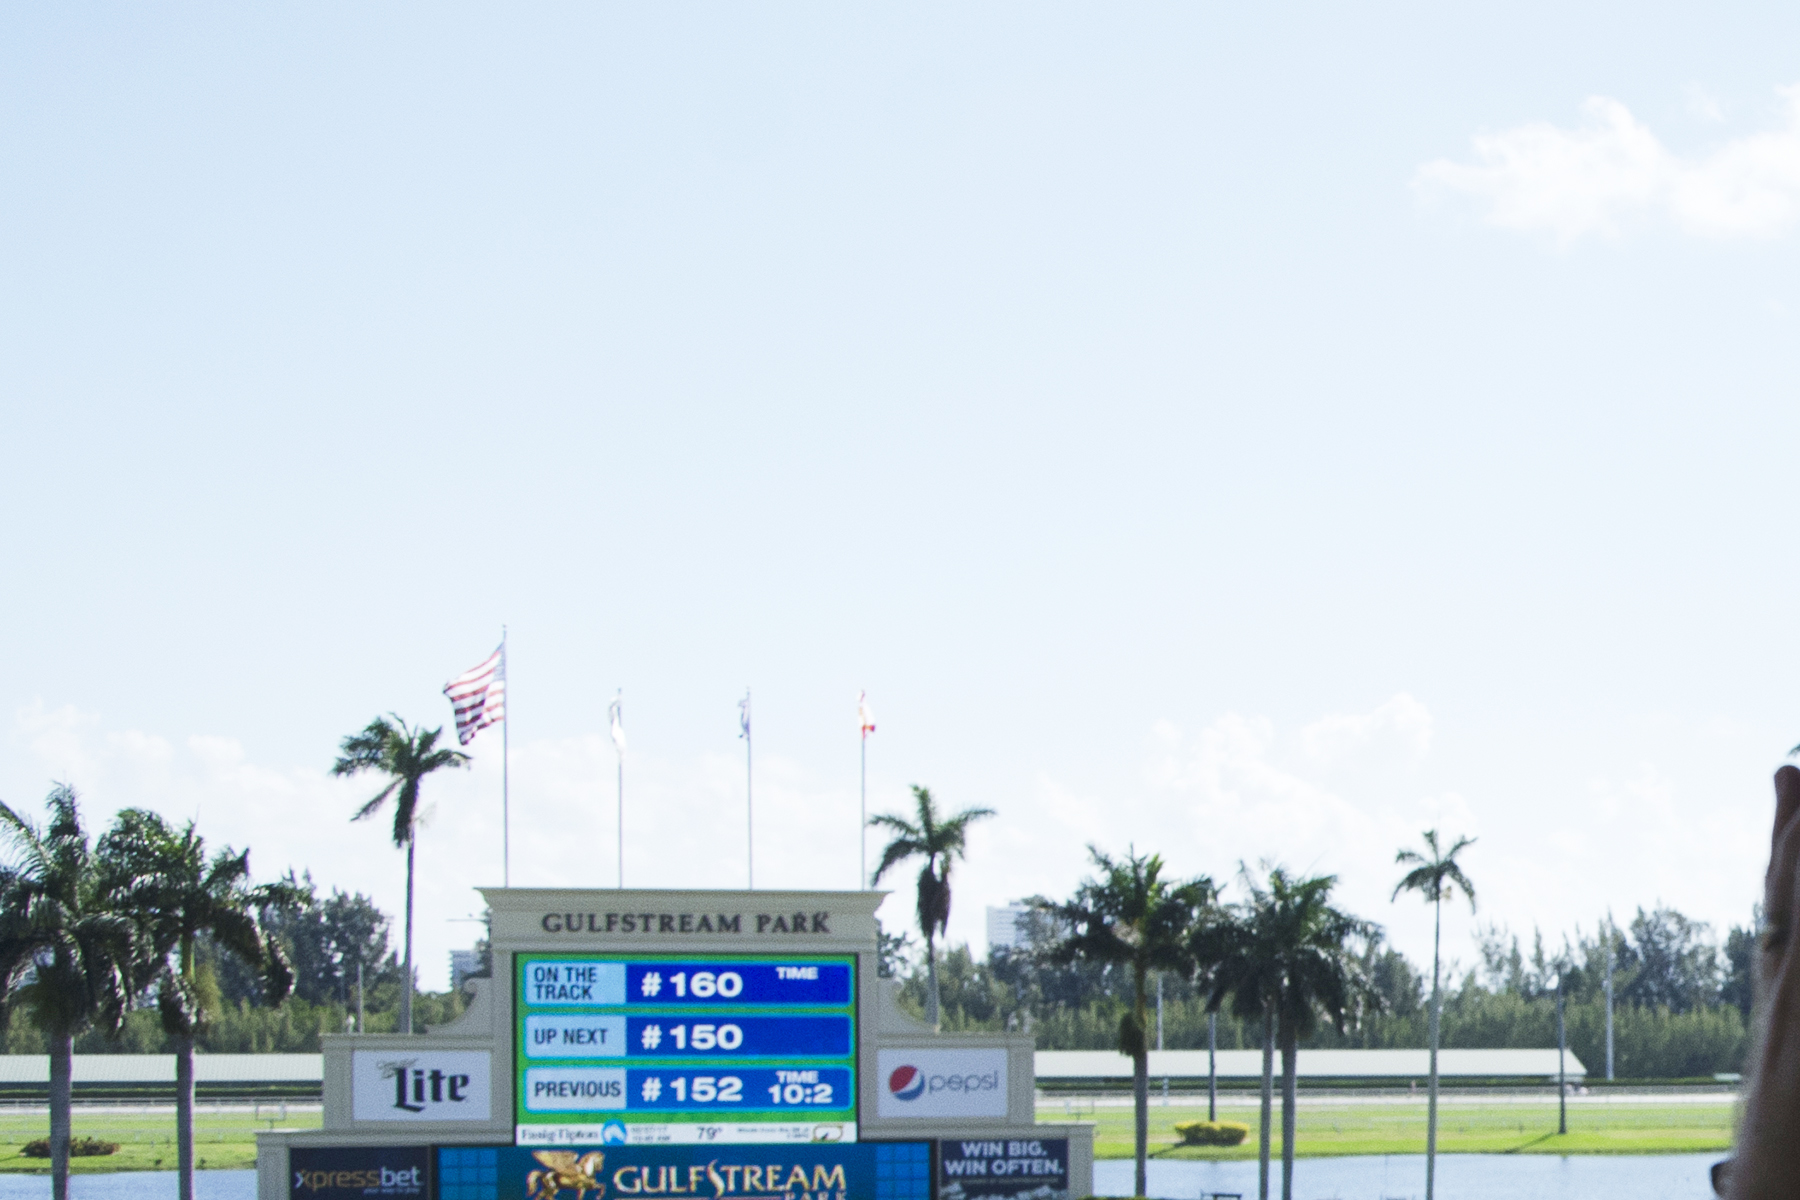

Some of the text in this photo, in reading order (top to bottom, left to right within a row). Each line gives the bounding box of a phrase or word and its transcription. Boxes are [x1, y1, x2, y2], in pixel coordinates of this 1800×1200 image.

[541, 911, 832, 934] GULFSTREAM PARK
[534, 967, 597, 983] ON THE
[776, 966, 819, 980] TIME
[534, 984, 593, 1000] TRACK
[534, 1029, 608, 1045] UP NEXT
[776, 1070, 820, 1084] TIME
[928, 1070, 999, 1095] pepsi
[393, 1067, 470, 1113] Lite
[534, 1081, 622, 1098] PREVIOUS
[768, 1083, 834, 1105] 10:2
[961, 1140, 1048, 1157] WIN BIG.
[945, 1159, 1065, 1176] WIN OFTEN.
[613, 1159, 848, 1200] GULFSTREAM
